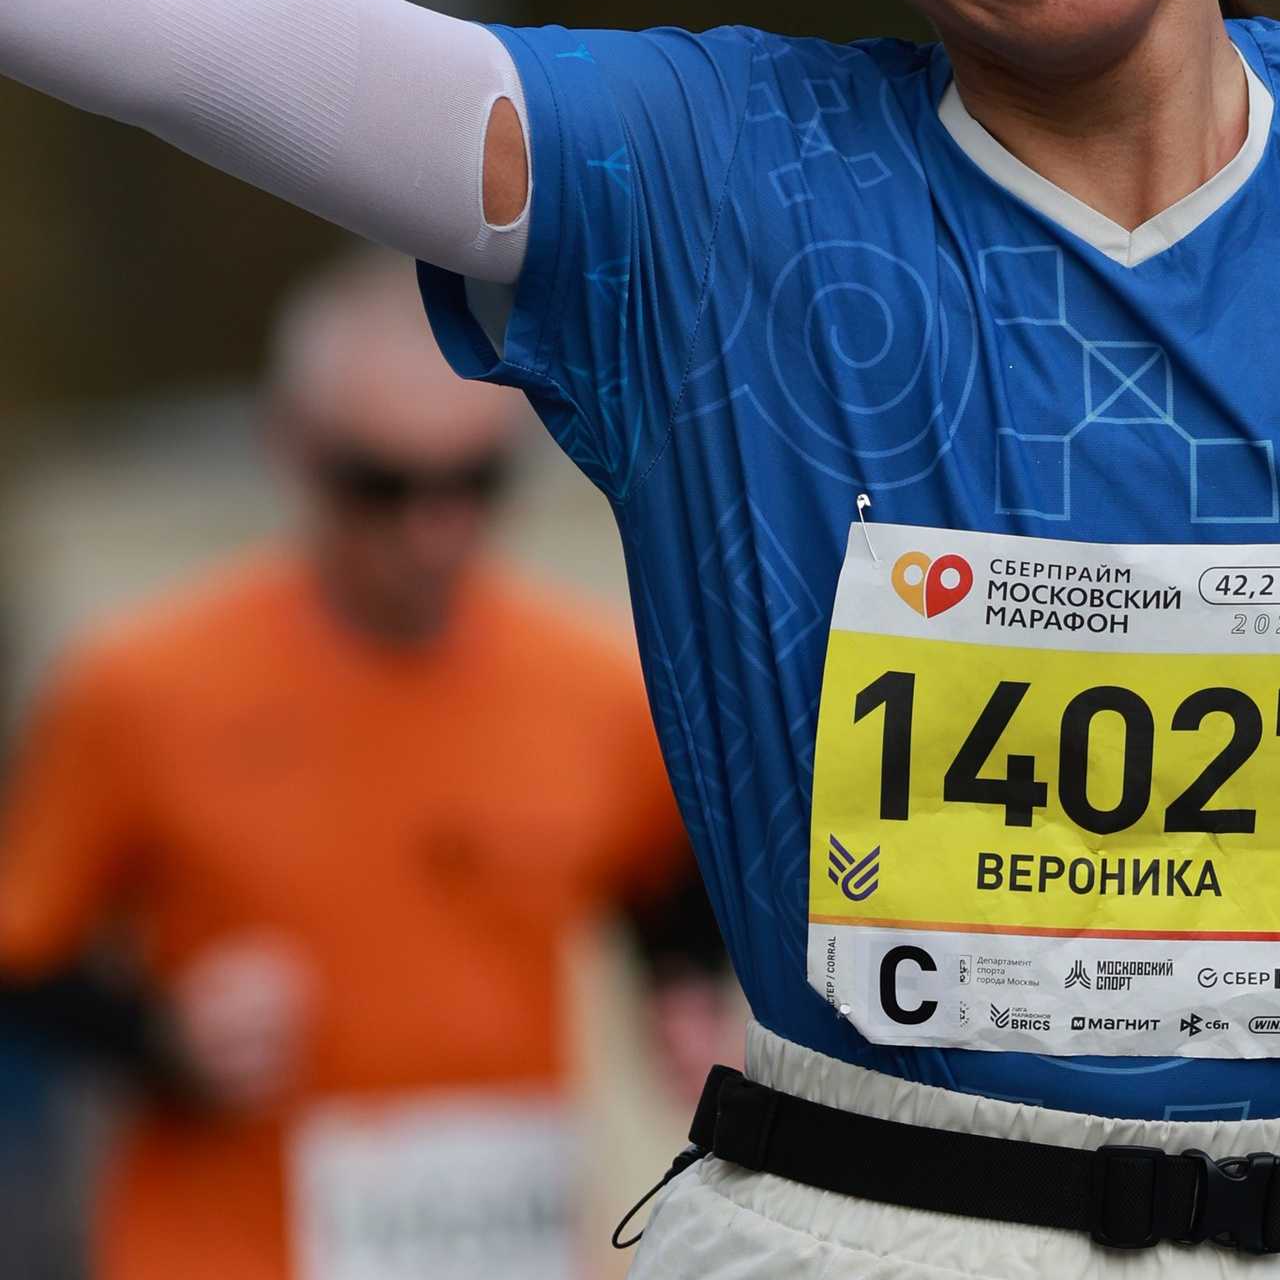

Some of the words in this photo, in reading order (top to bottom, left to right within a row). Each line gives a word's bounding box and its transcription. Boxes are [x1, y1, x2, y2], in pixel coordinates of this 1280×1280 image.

[990, 558, 1131, 583] СБЕРПРАЙМ
[987, 580, 1181, 610] МОСКОВСКИЙ
[1215, 574, 1275, 599] 42,2
[985, 605, 1129, 634] МАРАФОН
[976, 853, 1222, 897] ВЕРОНИКА
[827, 936, 836, 973] CORRAL
[977, 956, 1032, 967] Департамент
[977, 967, 1005, 976] спорта
[1096, 959, 1173, 976] МОСКОВСКИЙ
[879, 945, 938, 1025] C
[977, 977, 1005, 985] города
[1007, 978, 1040, 986] Москвы
[1096, 977, 1132, 990] СПОРТ
[1223, 972, 1270, 985] СБЕР
[826, 981, 836, 1008] СТЕР
[1011, 1019, 1050, 1031] BRICS
[1088, 1018, 1160, 1030] магнит
[1205, 1020, 1229, 1030] сбп
